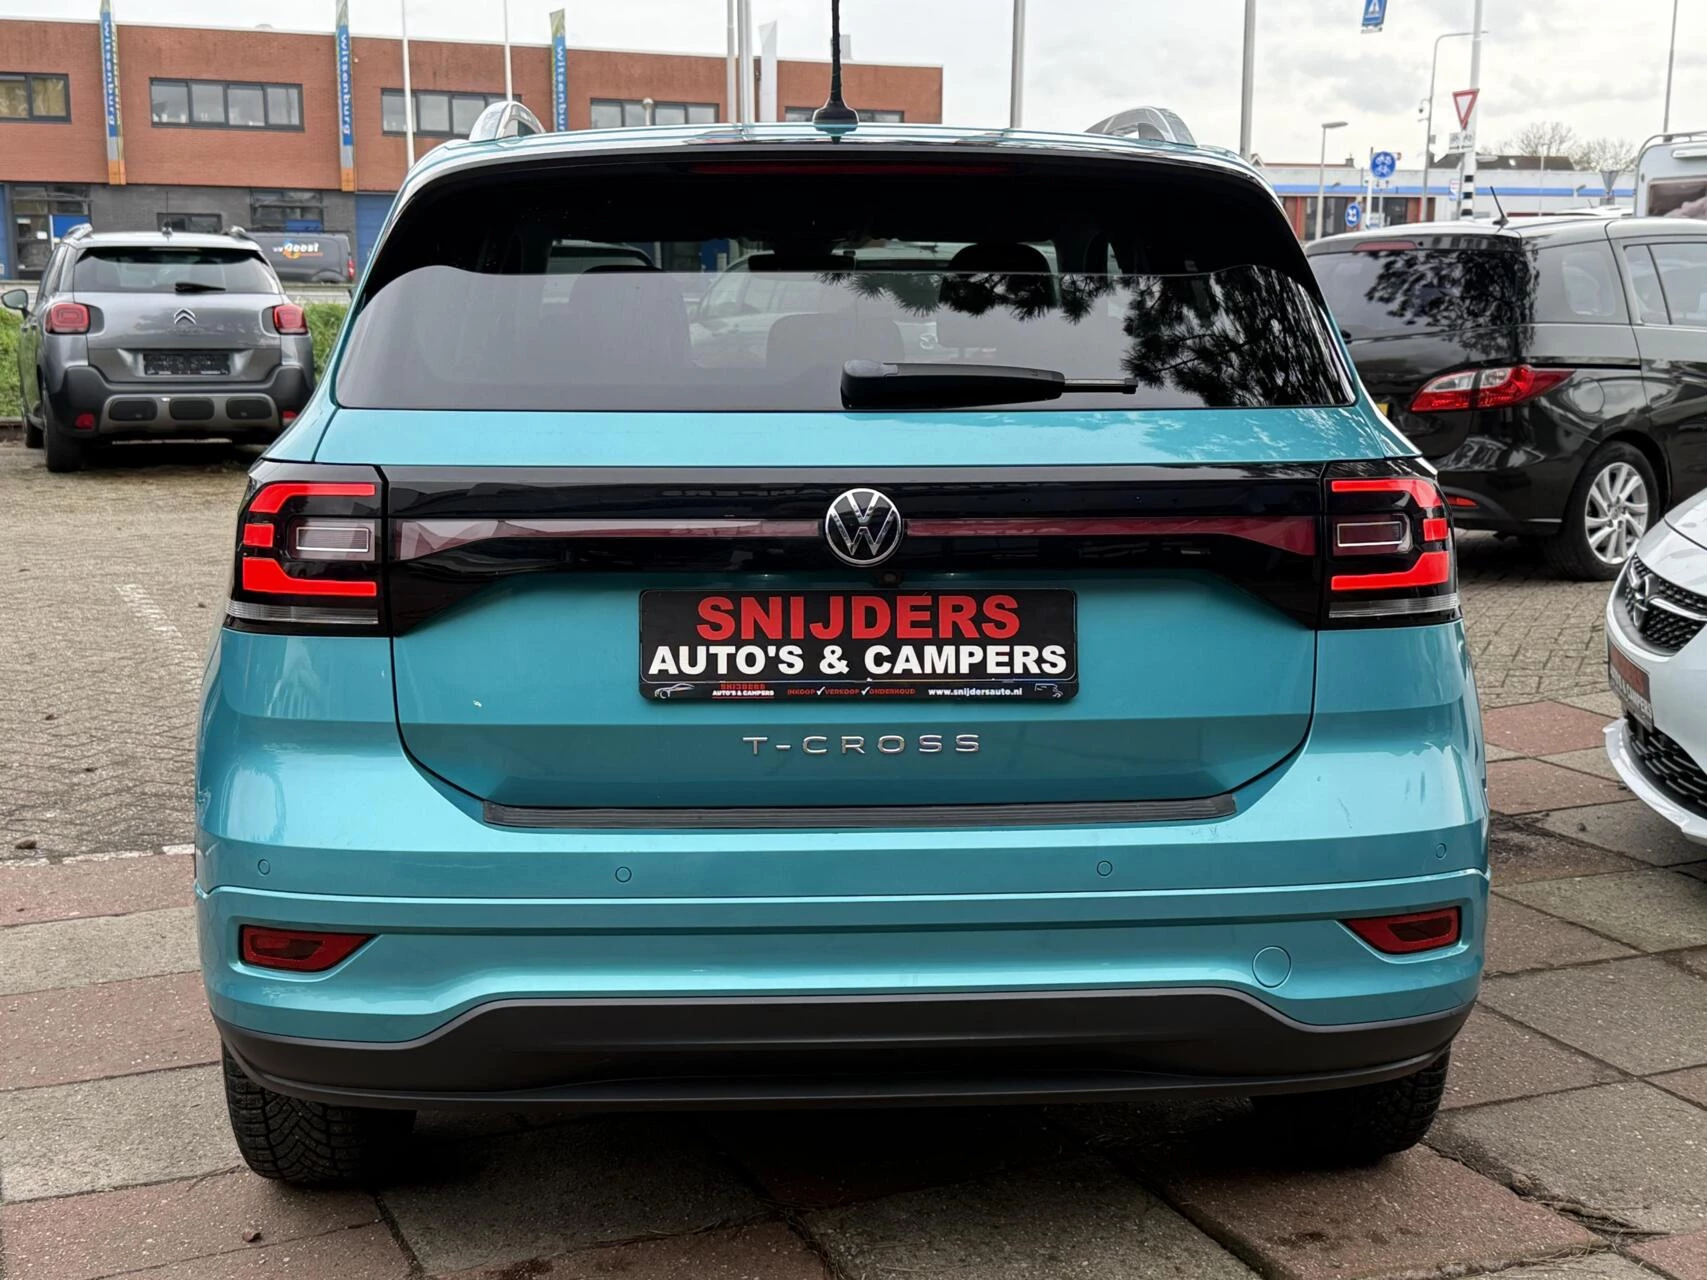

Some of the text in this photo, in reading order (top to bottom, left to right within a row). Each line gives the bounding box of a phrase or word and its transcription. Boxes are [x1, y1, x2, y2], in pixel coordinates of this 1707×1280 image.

[341, 34, 351, 135] witsenburg
[557, 46, 567, 131] witsenbur
[695, 594, 1020, 640] SNIJDERS
[648, 644, 1067, 675] AUTO'S & CAMPERS
[928, 687, 1023, 697] www.snijdersauto.nl
[742, 734, 981, 756] T-CROSS
